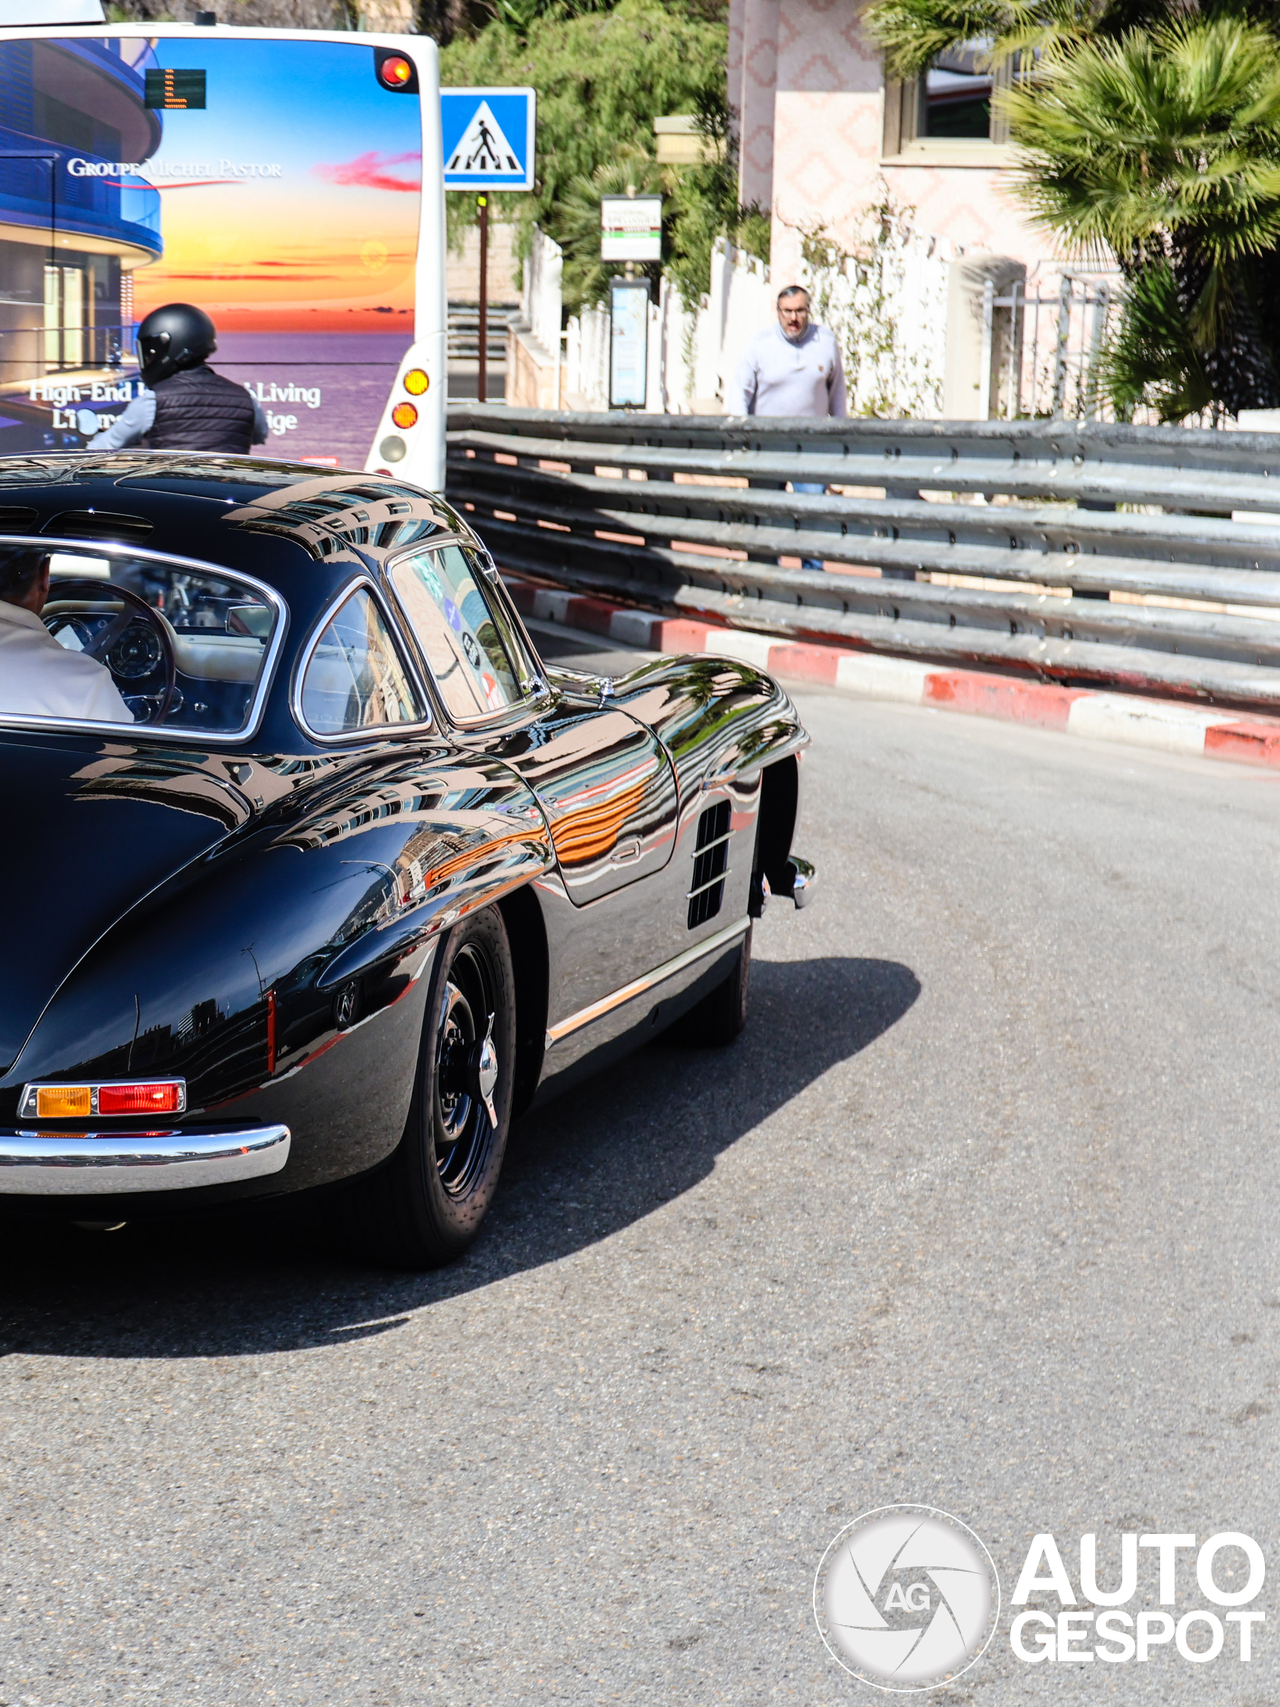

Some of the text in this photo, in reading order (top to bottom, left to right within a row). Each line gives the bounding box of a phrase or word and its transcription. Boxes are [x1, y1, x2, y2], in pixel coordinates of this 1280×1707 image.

[219, 159, 283, 178] PASTOR
[28, 381, 133, 408] High-End
[256, 382, 321, 409] Living
